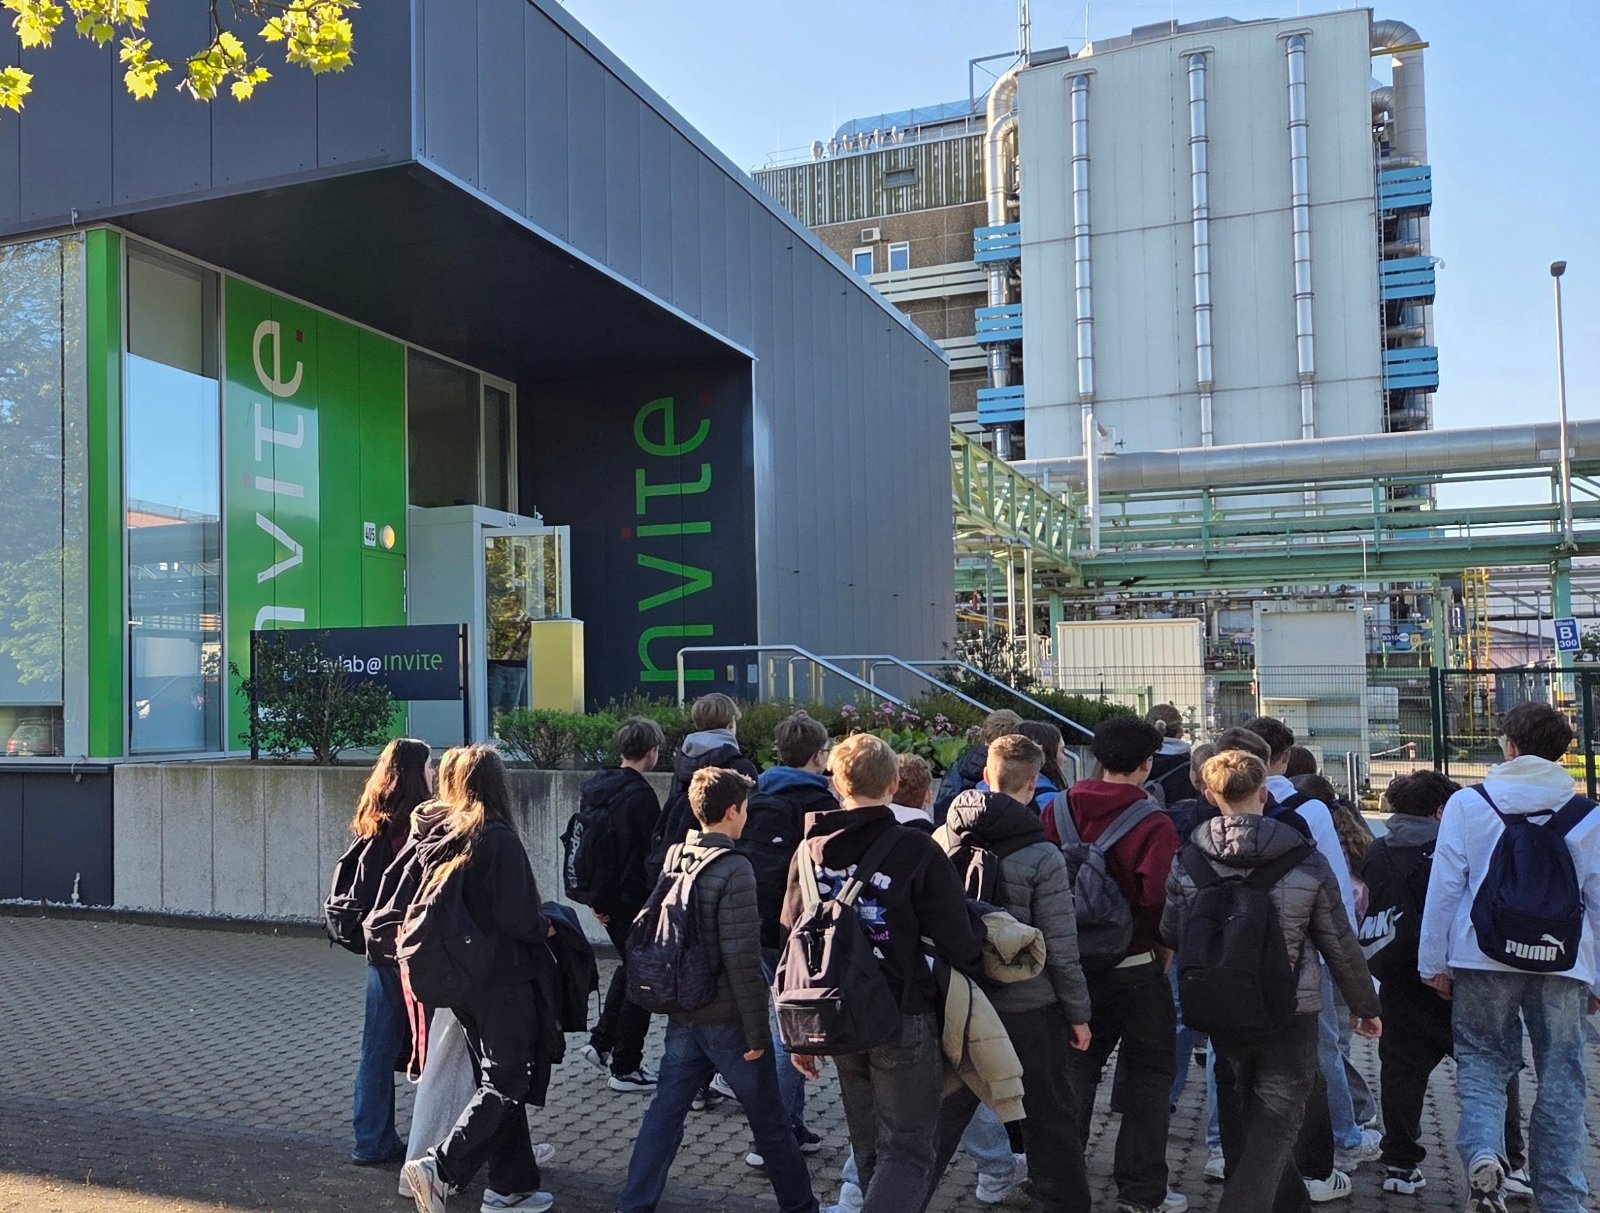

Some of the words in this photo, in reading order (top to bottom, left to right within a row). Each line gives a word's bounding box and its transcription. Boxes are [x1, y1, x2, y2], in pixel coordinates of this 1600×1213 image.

[1560, 626, 1573, 640] B
[1560, 639, 1577, 648] 300
[1505, 939, 1558, 961] PUMA
